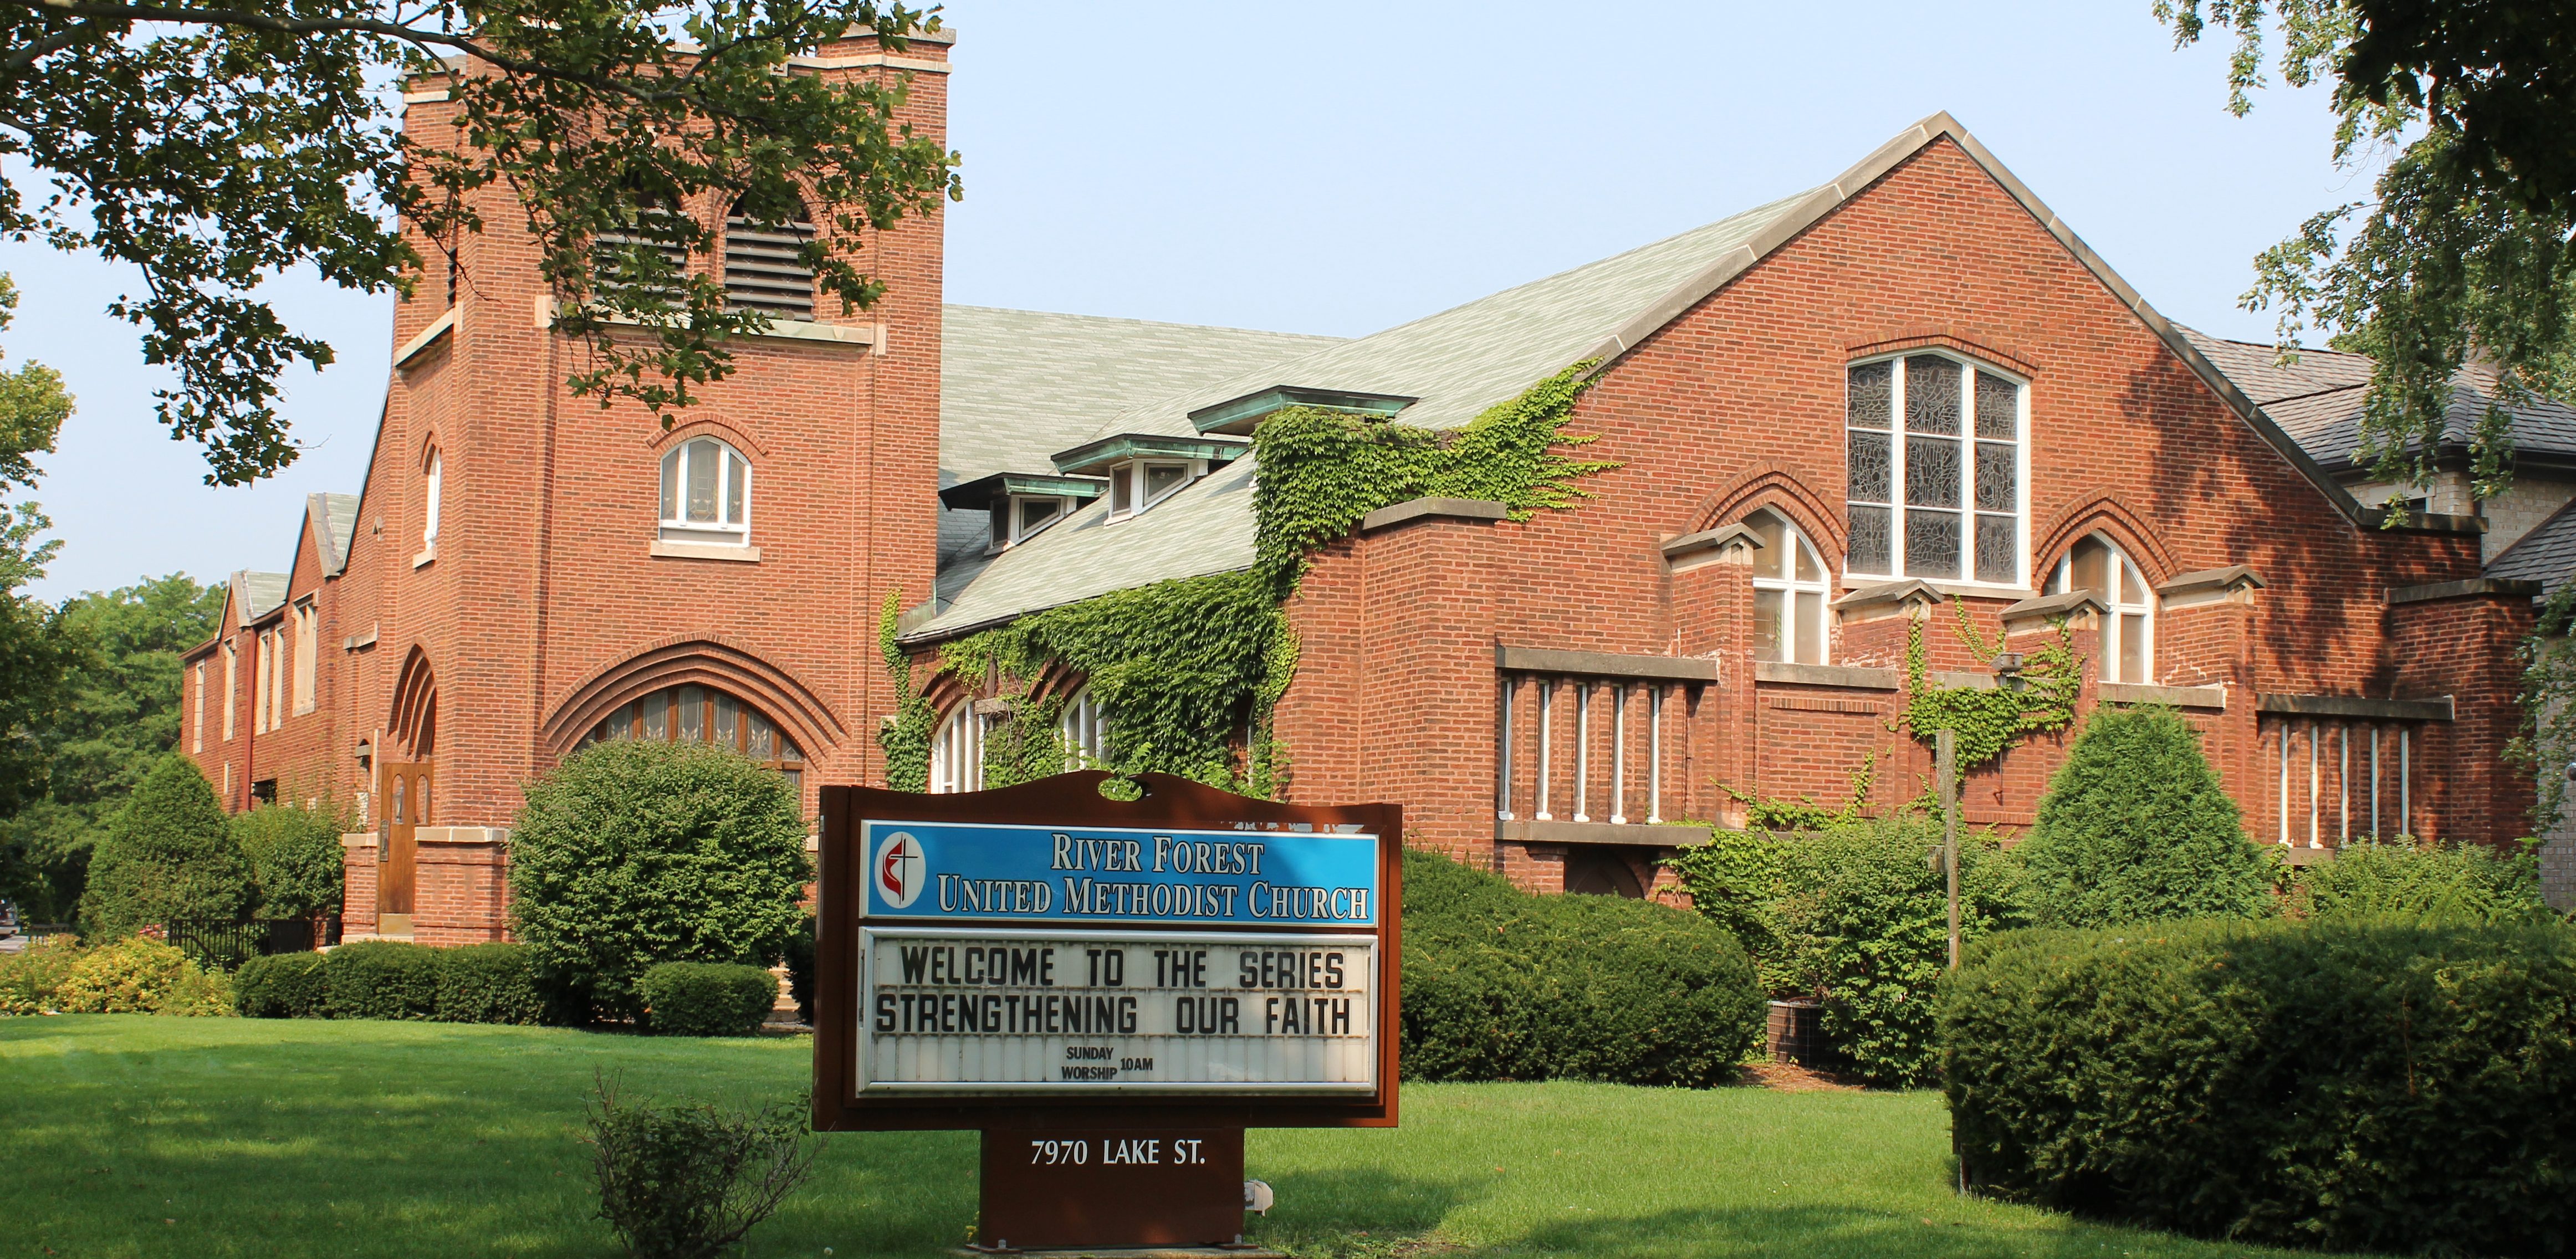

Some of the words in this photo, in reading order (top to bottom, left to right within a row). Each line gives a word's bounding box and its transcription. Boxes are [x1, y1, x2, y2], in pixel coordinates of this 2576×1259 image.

[1051, 833, 1142, 872] RIVER
[1152, 836, 1265, 875] FOREST
[937, 874, 1052, 913] UNITED
[1062, 877, 1237, 917] METHODIST
[1248, 881, 1368, 920] CHURCH
[900, 945, 1054, 986] WELCOME
[1087, 949, 1123, 987] TO
[1154, 950, 1207, 988] THE
[1239, 950, 1343, 989] SERIES
[876, 994, 1137, 1034] STRENGTHENING
[1176, 996, 1239, 1035] OUR
[1266, 997, 1350, 1035] FAITH
[1066, 1046, 1114, 1060] SUNDAY
[1120, 1057, 1153, 1071] 10AM
[1061, 1066, 1118, 1081] WORSHIP
[1031, 1140, 1087, 1165] 7970
[1103, 1139, 1159, 1164] LAKE
[1174, 1139, 1205, 1164] ST.
